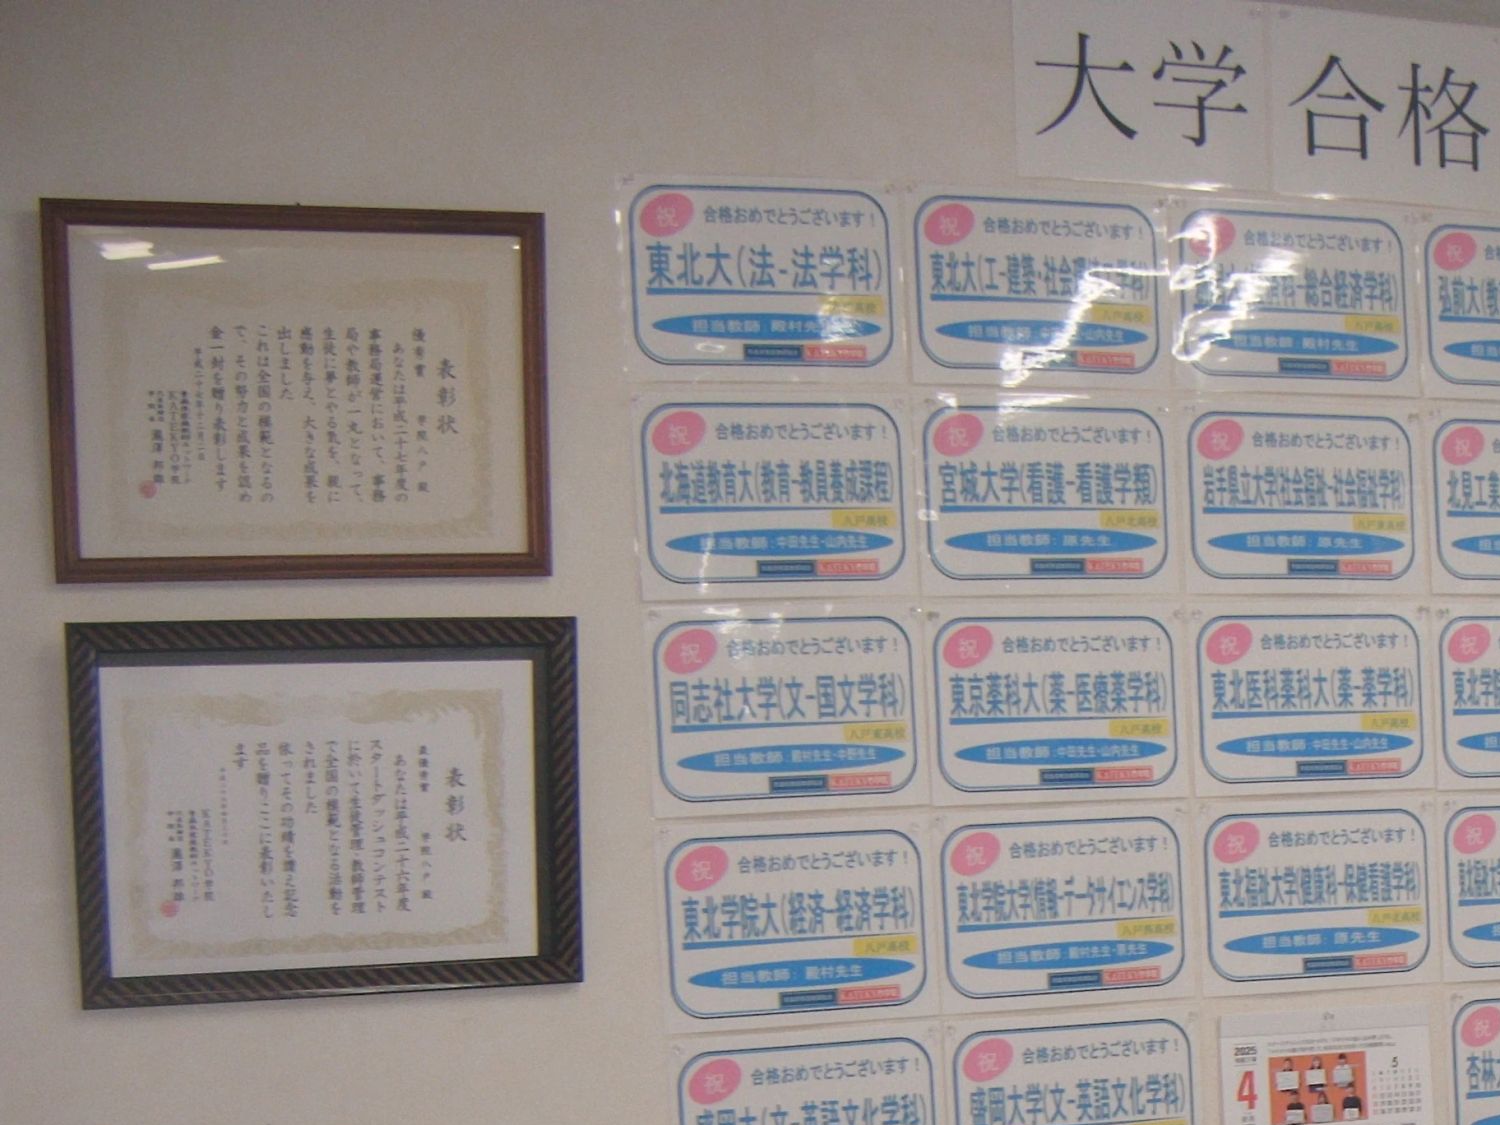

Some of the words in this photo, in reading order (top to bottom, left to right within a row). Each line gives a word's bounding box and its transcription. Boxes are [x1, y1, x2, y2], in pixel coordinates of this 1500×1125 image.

[278, 326, 295, 400] 出しました
[438, 358, 459, 434] 表彰状
[232, 743, 248, 770] ます
[303, 741, 317, 814] されました
[445, 767, 467, 841] 表彰状
[1237, 1070, 1258, 1110] 4
